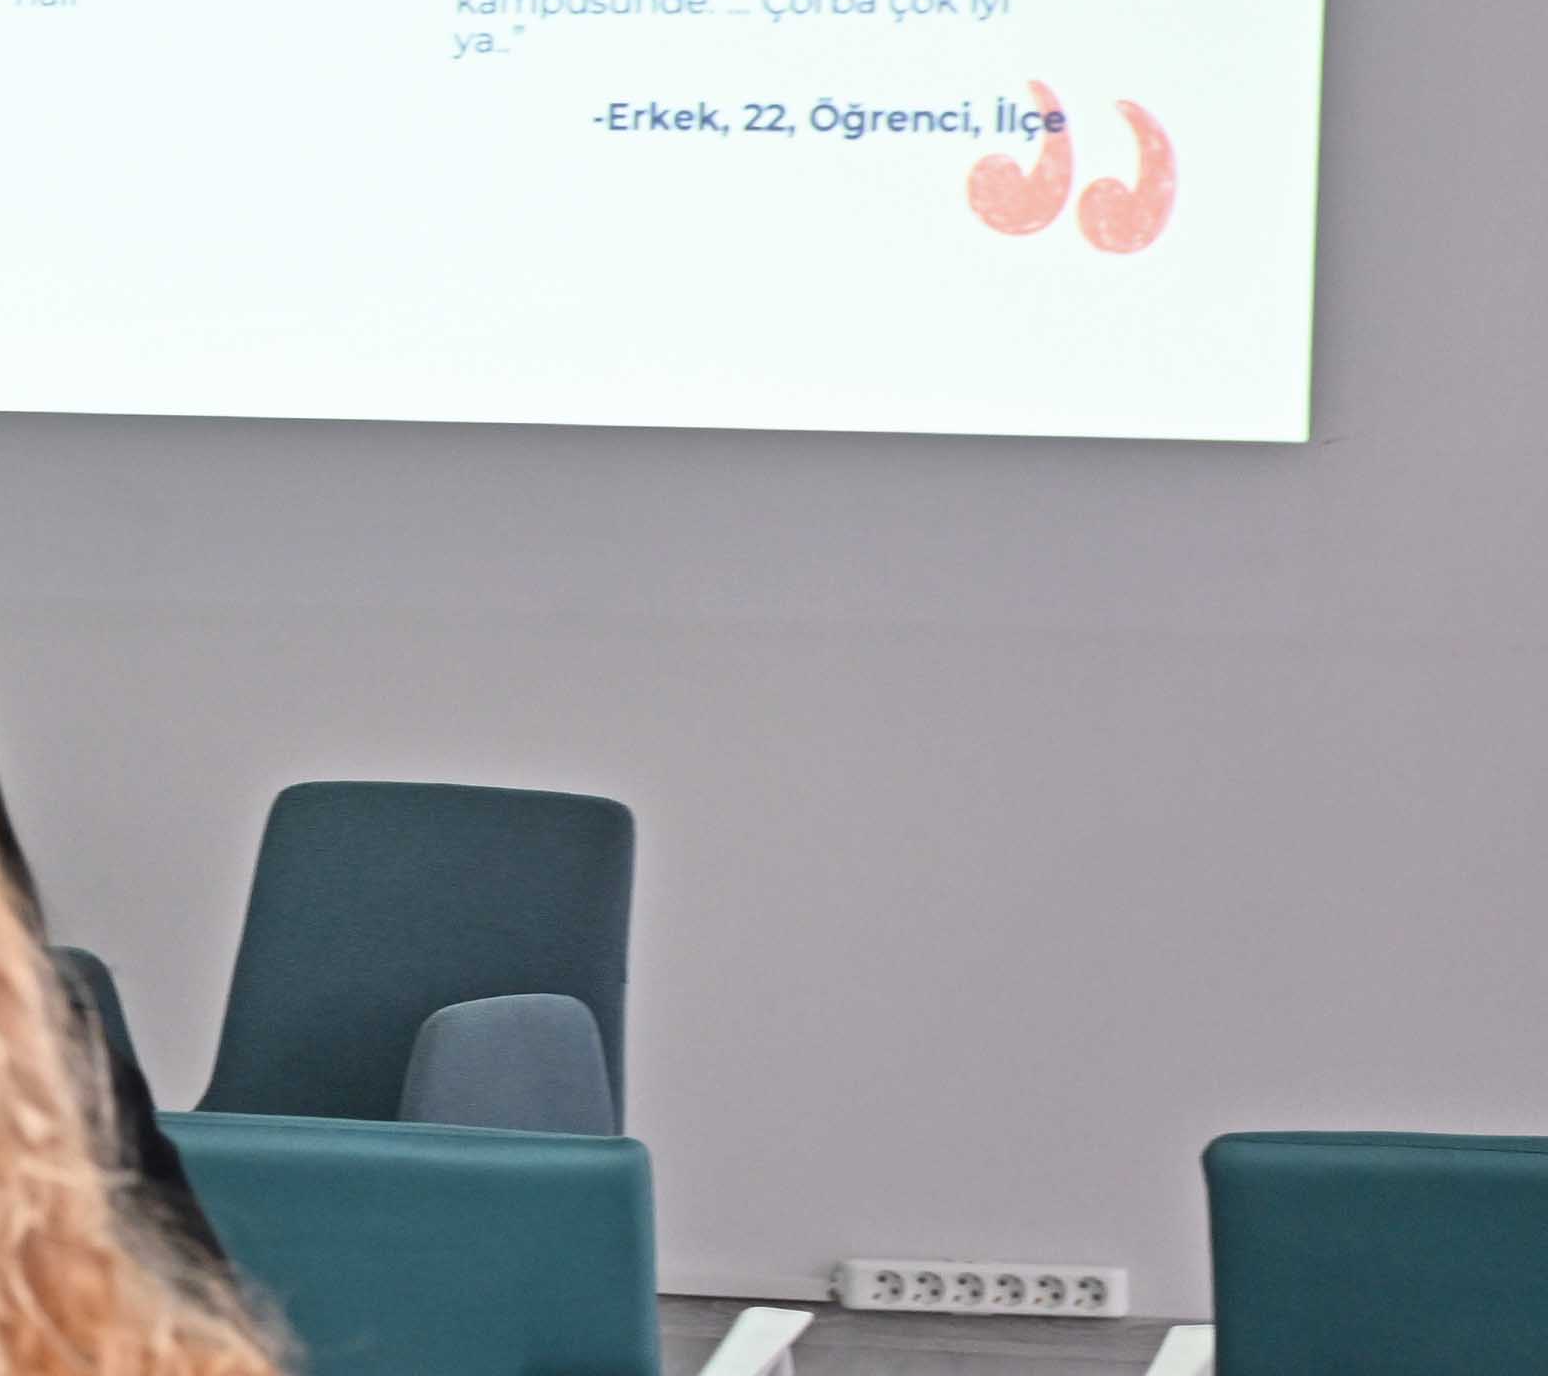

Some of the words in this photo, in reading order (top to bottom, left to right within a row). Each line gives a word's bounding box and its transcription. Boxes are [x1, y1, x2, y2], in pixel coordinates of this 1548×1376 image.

[592, 101, 731, 137] -Erkek,
[743, 103, 796, 137] 22,
[809, 96, 982, 141] Öğrenci,
[995, 96, 1067, 142] İlçe
